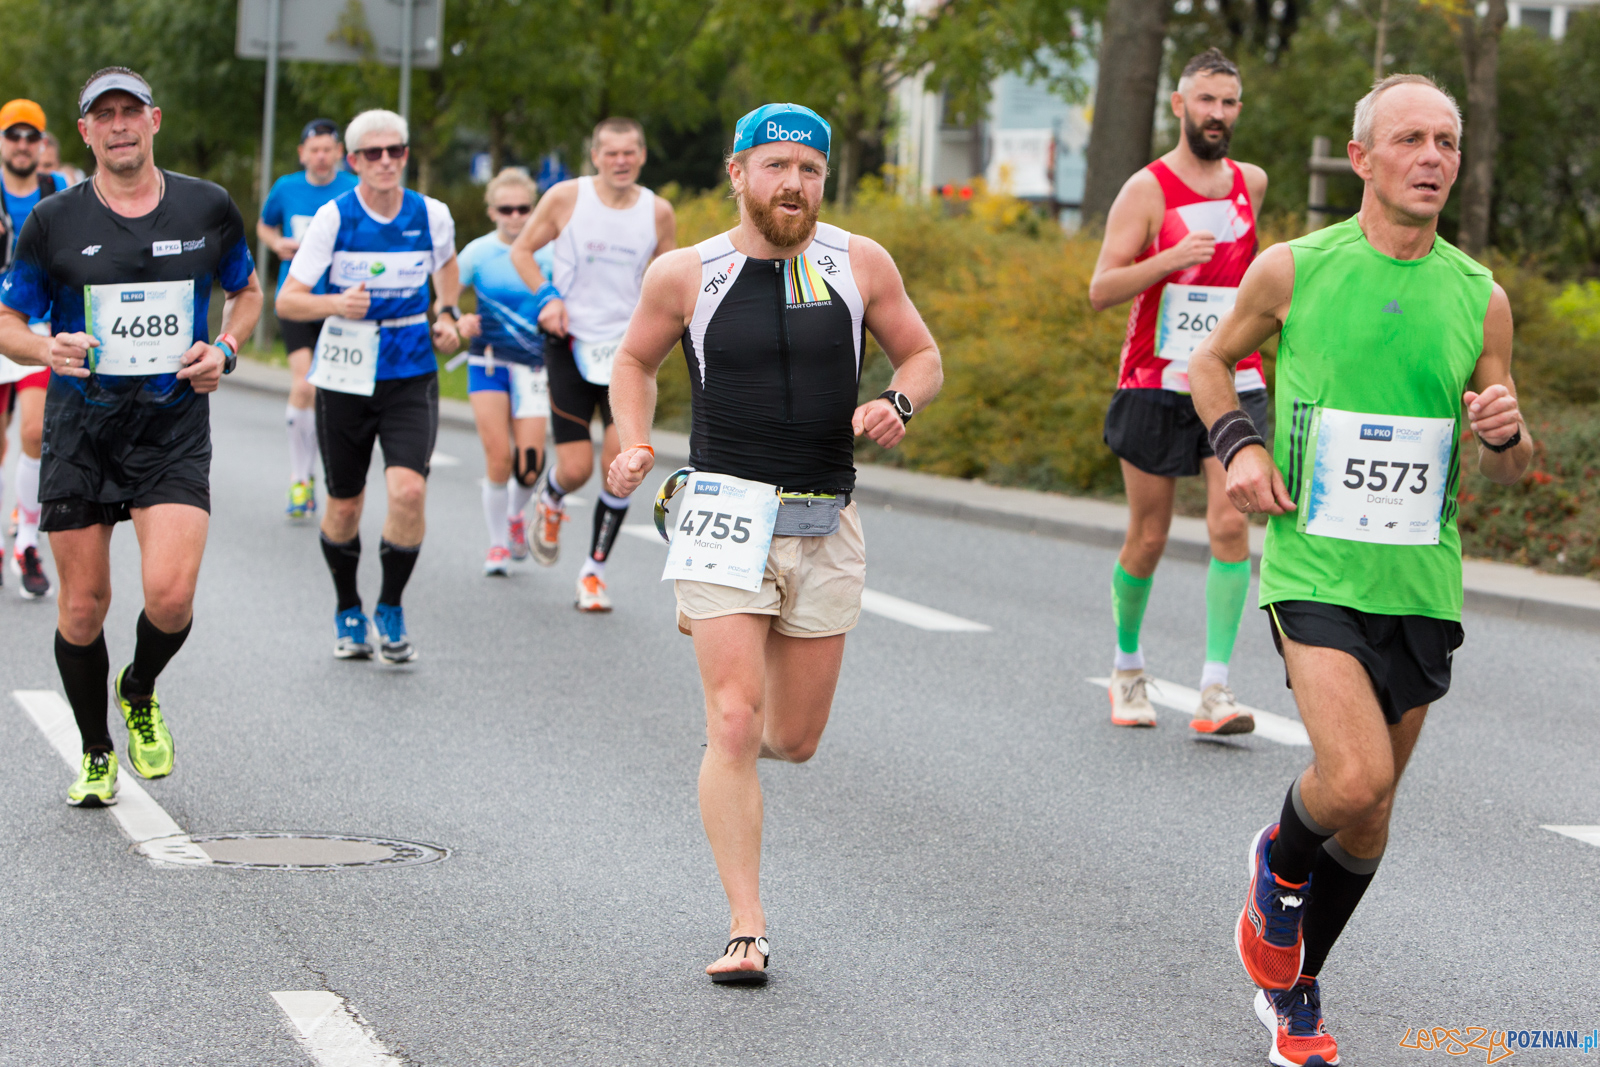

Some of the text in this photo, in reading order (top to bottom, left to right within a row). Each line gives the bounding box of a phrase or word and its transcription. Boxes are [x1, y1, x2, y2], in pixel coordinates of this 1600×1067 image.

[767, 121, 812, 141] Bbox
[81, 245, 102, 256] 4F
[817, 255, 840, 276] Tri
[704, 271, 728, 295] Tri
[786, 300, 833, 310] MARTOMBIKE
[111, 314, 179, 338] 4688
[1177, 312, 1219, 332] 260
[132, 339, 161, 347] Tomasz
[323, 343, 363, 365] 2210
[1363, 428, 1373, 436] 18.
[1374, 429, 1391, 437] PKO
[1343, 458, 1429, 494] 5573
[1367, 494, 1403, 506] Dariusz
[679, 510, 752, 543] 4755
[694, 539, 723, 550] Marcin
